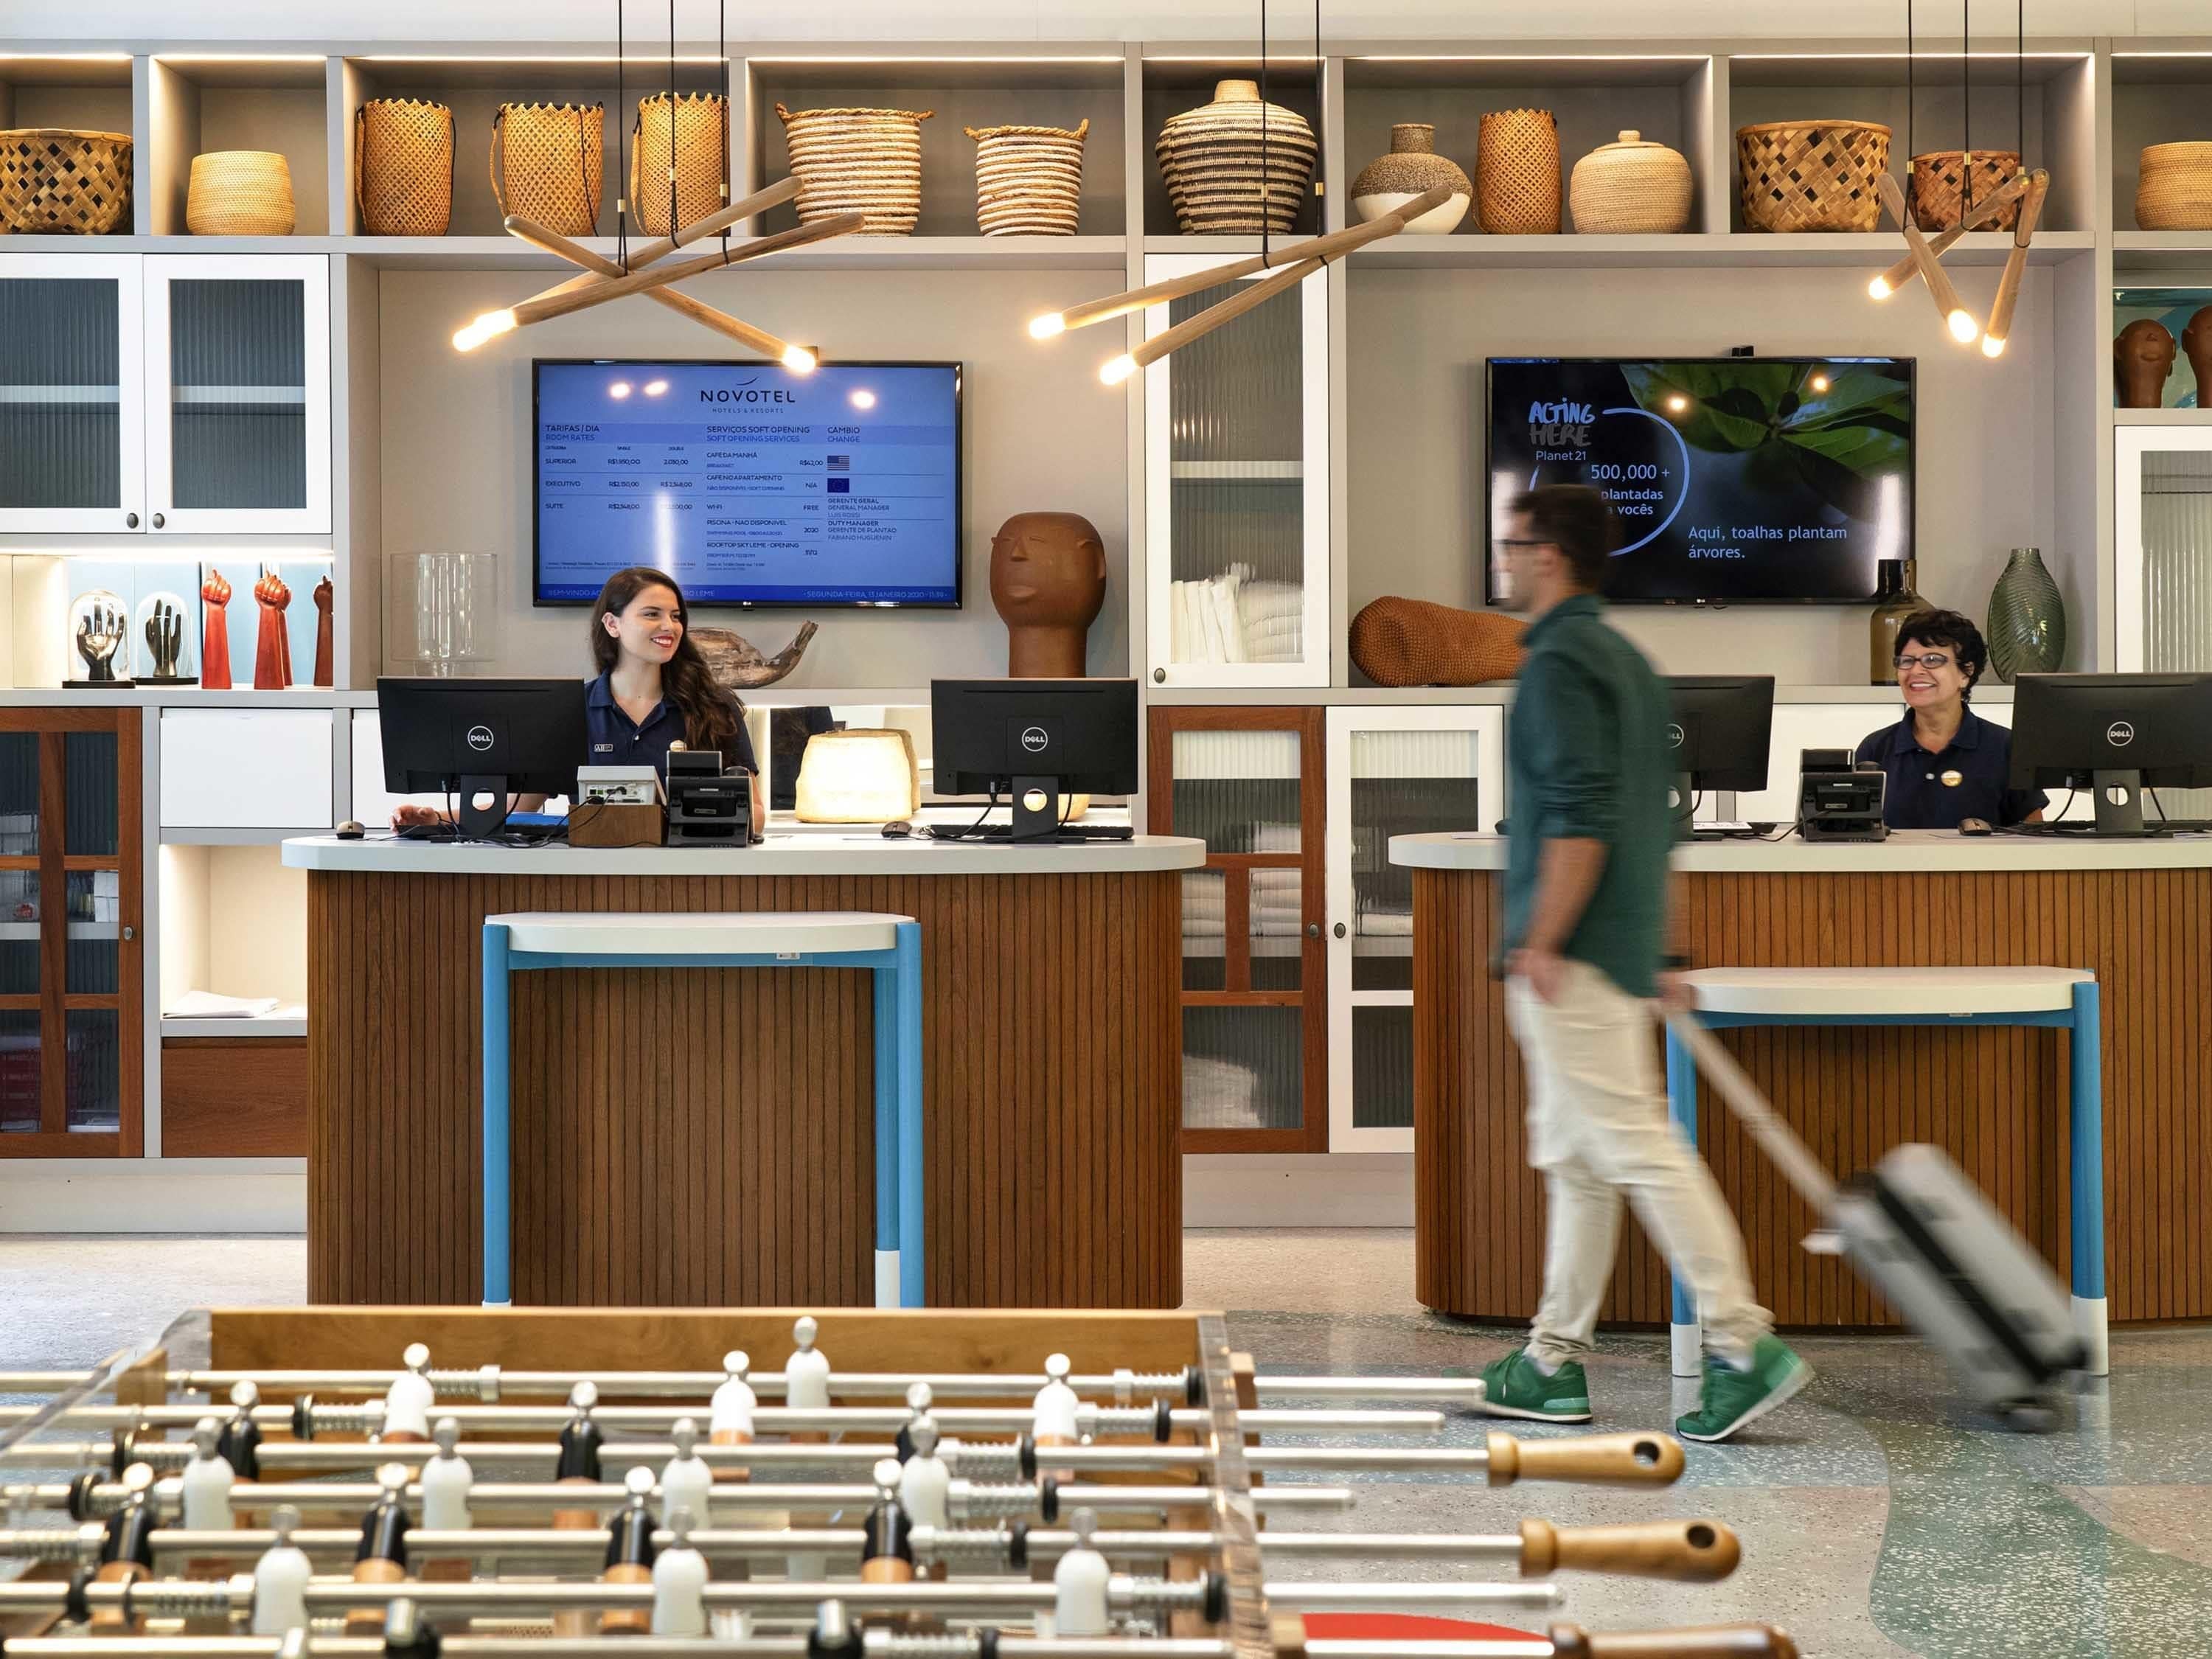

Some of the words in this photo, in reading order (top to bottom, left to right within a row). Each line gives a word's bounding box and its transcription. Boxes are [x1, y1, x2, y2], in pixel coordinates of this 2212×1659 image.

[700, 389, 796, 403] NOVOTEL
[1528, 397, 1596, 425] ACTING
[545, 425, 580, 433] TARIFAS
[585, 425, 600, 433] DIA
[748, 425, 771, 434] SOFT
[771, 425, 810, 434] OPENING
[1528, 424, 1593, 447] HERE
[545, 434, 570, 442] ROOM
[571, 434, 596, 442] RATES
[827, 435, 860, 443] CHANGE
[1536, 451, 1573, 461] Planet
[1574, 451, 1587, 461] 21
[1590, 464, 1657, 482] 500,000
[1661, 468, 1670, 478] +
[1601, 488, 1664, 501] plantadas
[1617, 503, 1653, 515] vocês
[1688, 525, 1726, 542] Aqui,
[1731, 525, 1784, 539] toalhas
[1788, 525, 1848, 542] plantam
[1688, 543, 1746, 559] árvores.
